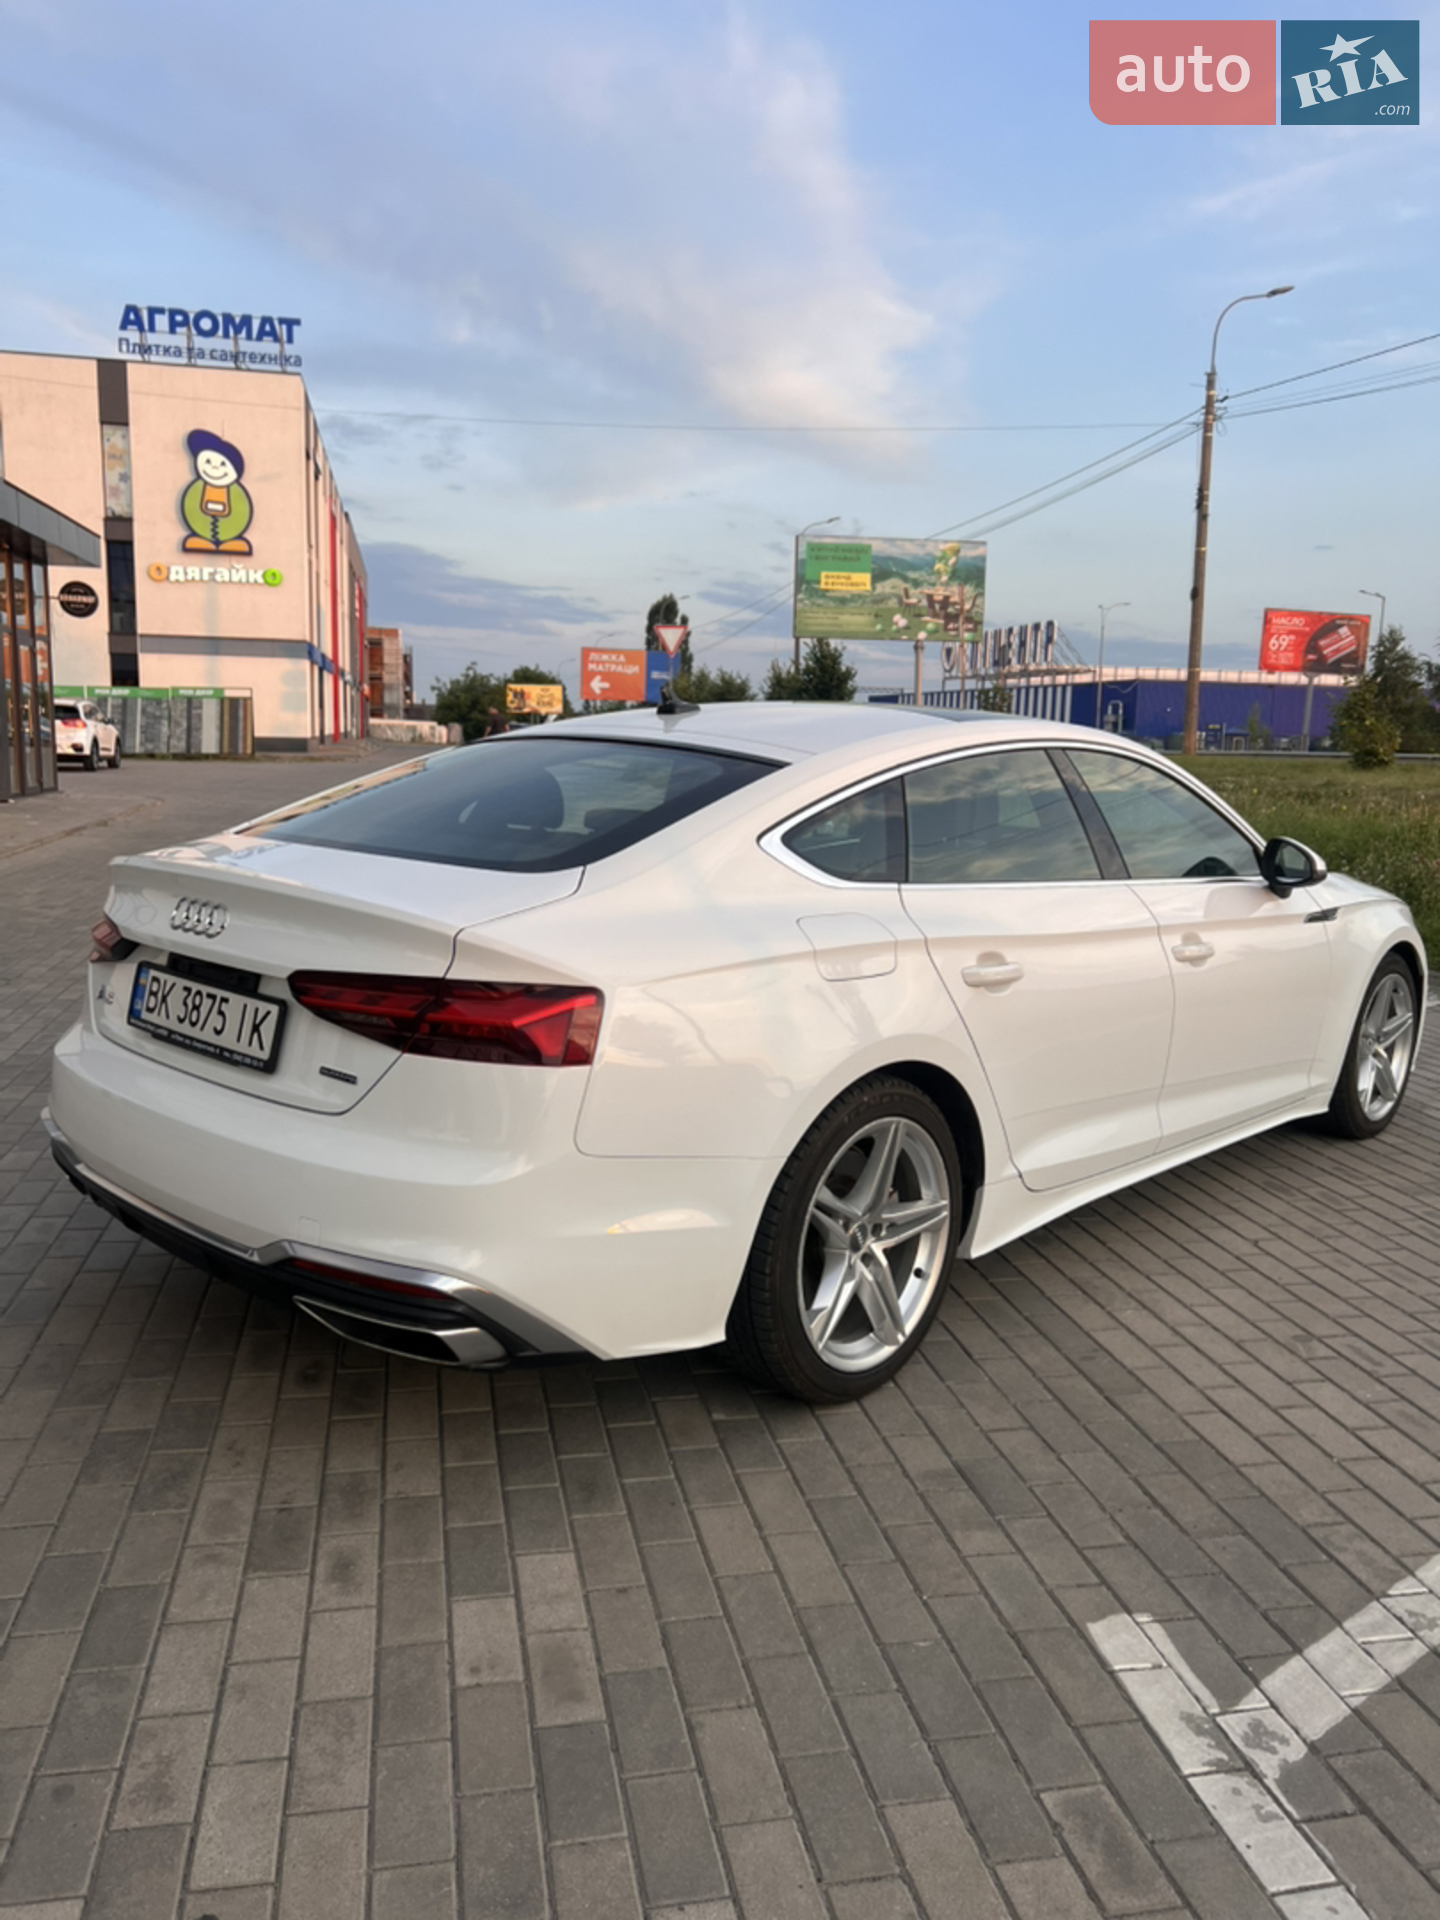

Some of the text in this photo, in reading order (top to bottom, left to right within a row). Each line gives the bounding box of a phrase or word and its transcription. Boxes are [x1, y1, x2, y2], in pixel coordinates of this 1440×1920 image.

[119, 304, 301, 345] АГРОМАТ
[117, 337, 182, 359] Плитка
[209, 347, 302, 367] сантехніка
[147, 562, 283, 587] Одягайко
[1268, 634, 1289, 652] 69
[587, 662, 640, 675] МАТРАЦИ
[145, 975, 177, 1020] BK
[176, 985, 230, 1037] 3875
[236, 1002, 272, 1052] IK
